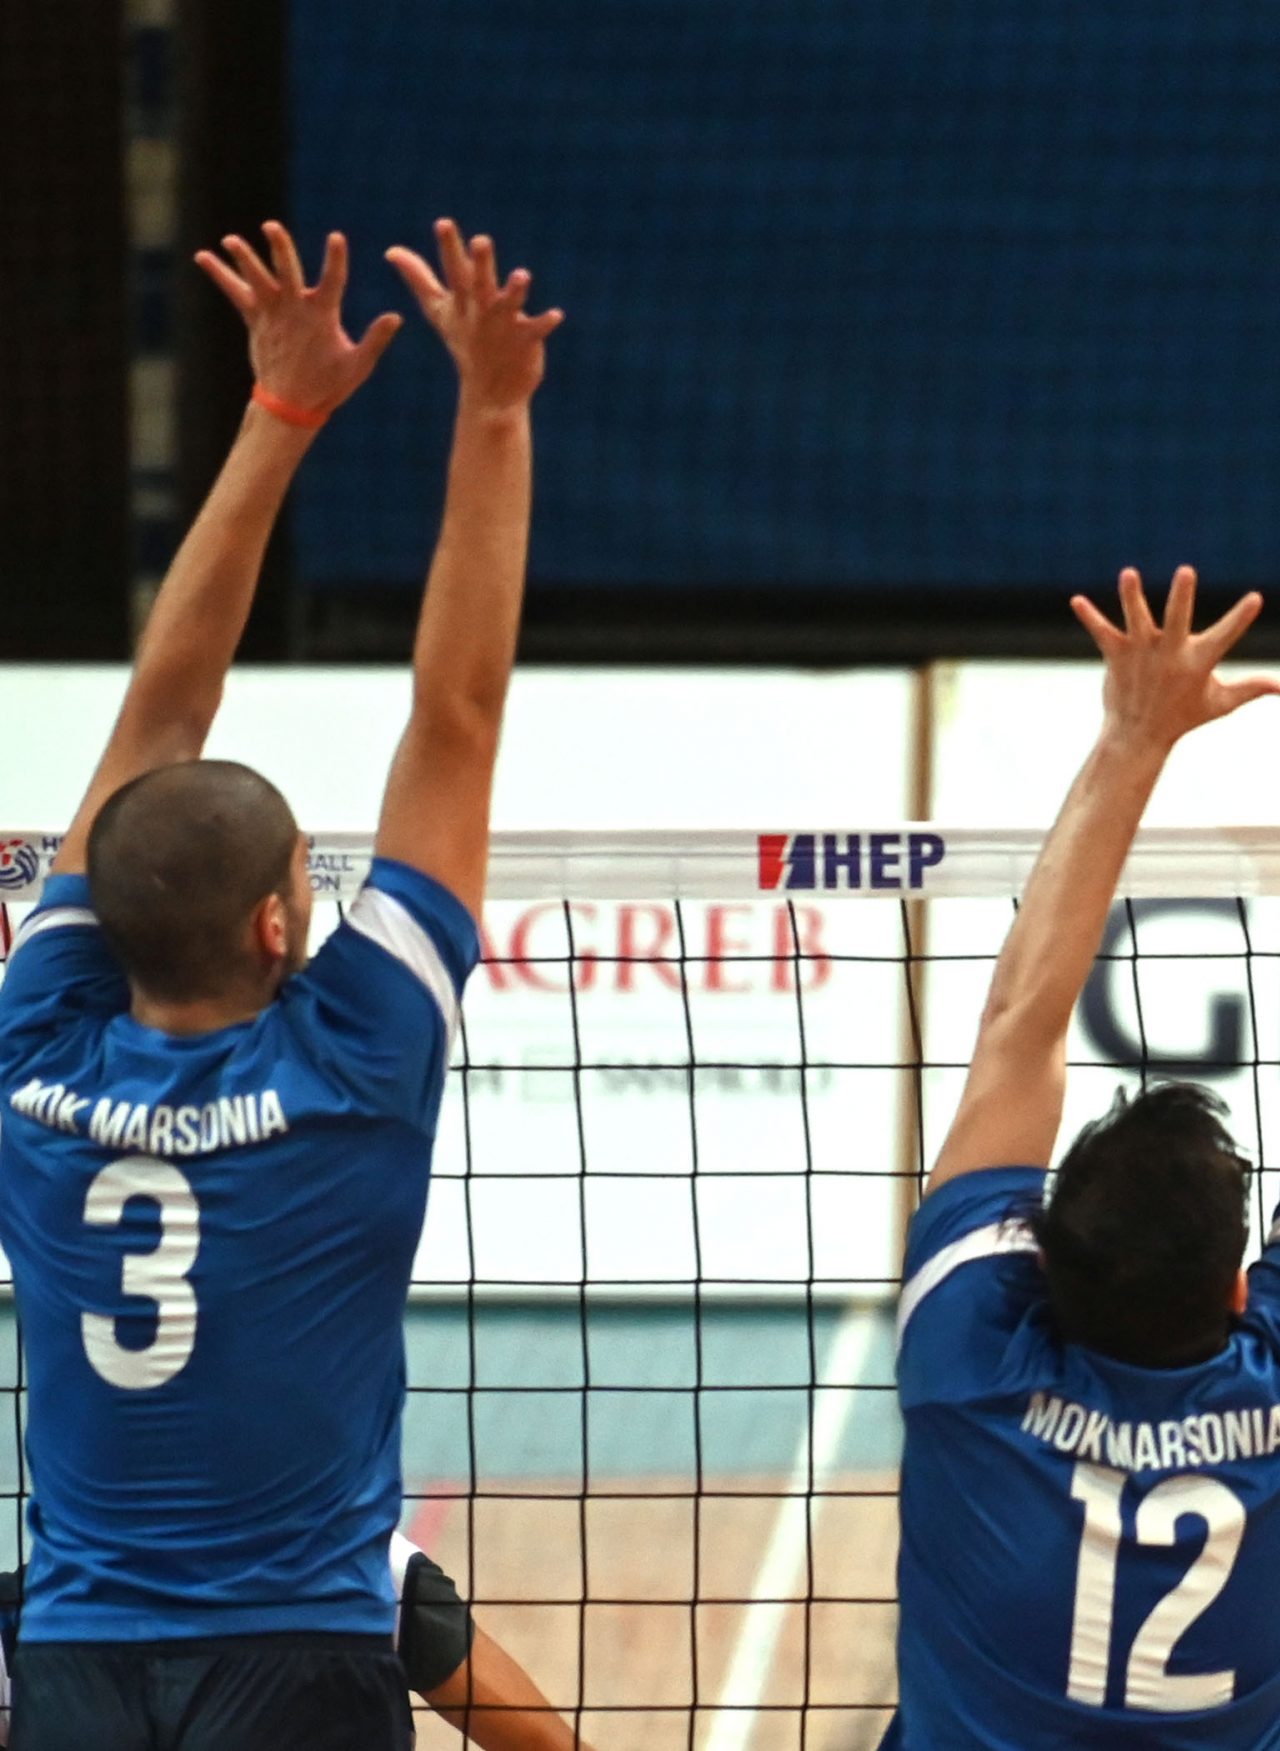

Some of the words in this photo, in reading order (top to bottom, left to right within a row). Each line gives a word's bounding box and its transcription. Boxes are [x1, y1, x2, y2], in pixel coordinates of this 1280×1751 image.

[822, 832, 945, 890] HEP
[479, 902, 834, 993] GREB
[10, 1078, 90, 1132] MOK
[89, 1089, 288, 1154] MARSONIA
[81, 1155, 200, 1390] 3
[1021, 1391, 1108, 1461] MOK
[1066, 1461, 1246, 1712] 12
